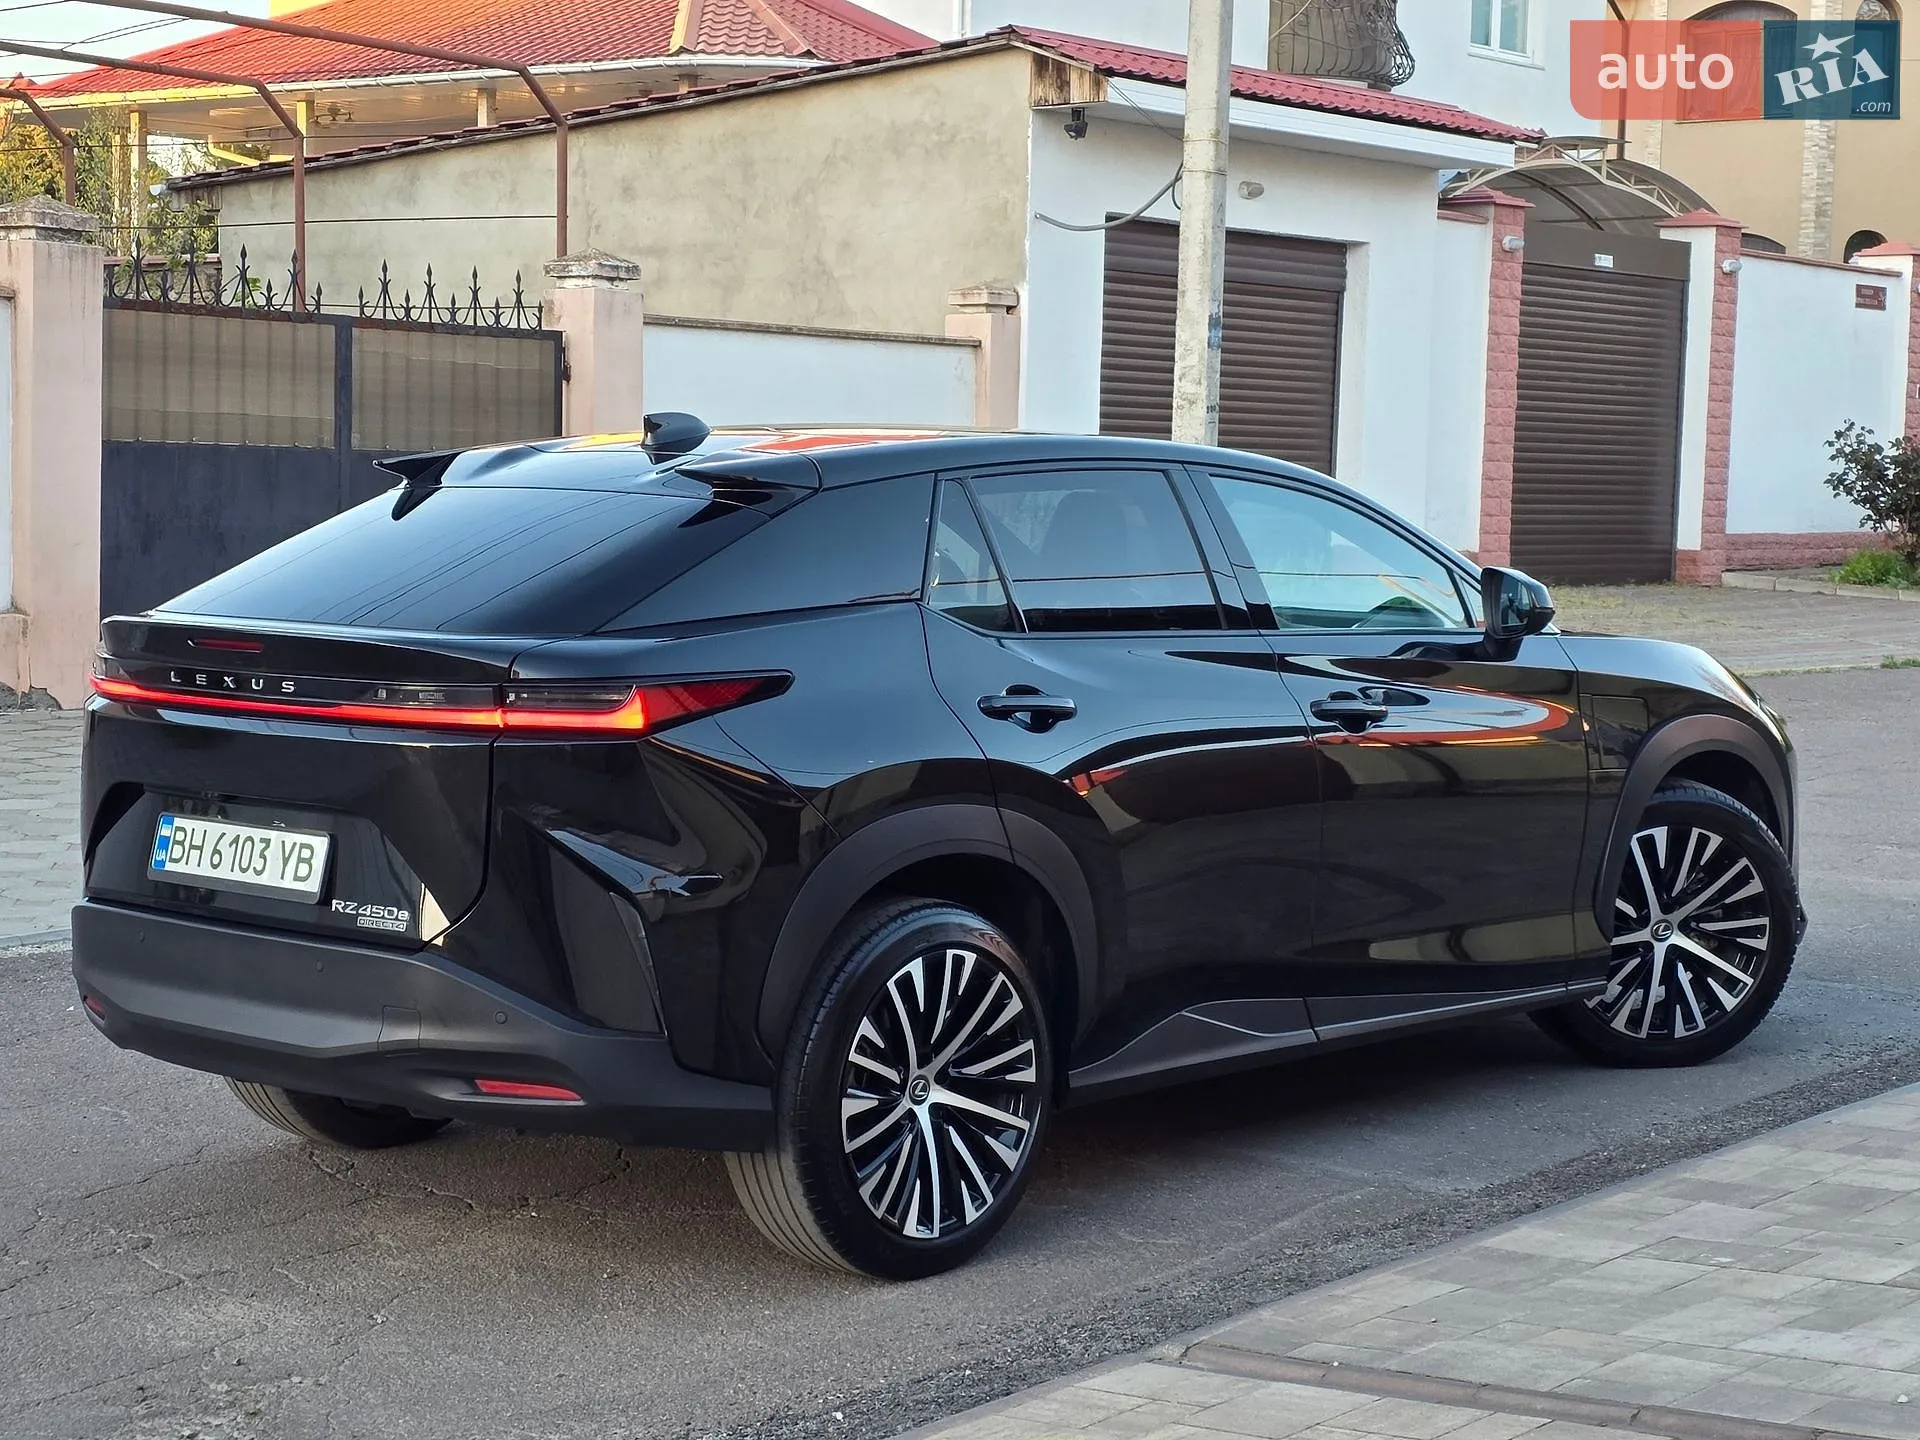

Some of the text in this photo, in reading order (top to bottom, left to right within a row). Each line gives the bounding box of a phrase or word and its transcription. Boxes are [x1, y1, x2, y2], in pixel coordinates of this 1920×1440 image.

[170, 670, 295, 693] LEXUS
[155, 850, 166, 862] UA
[168, 826, 315, 882] BH 6103 YB
